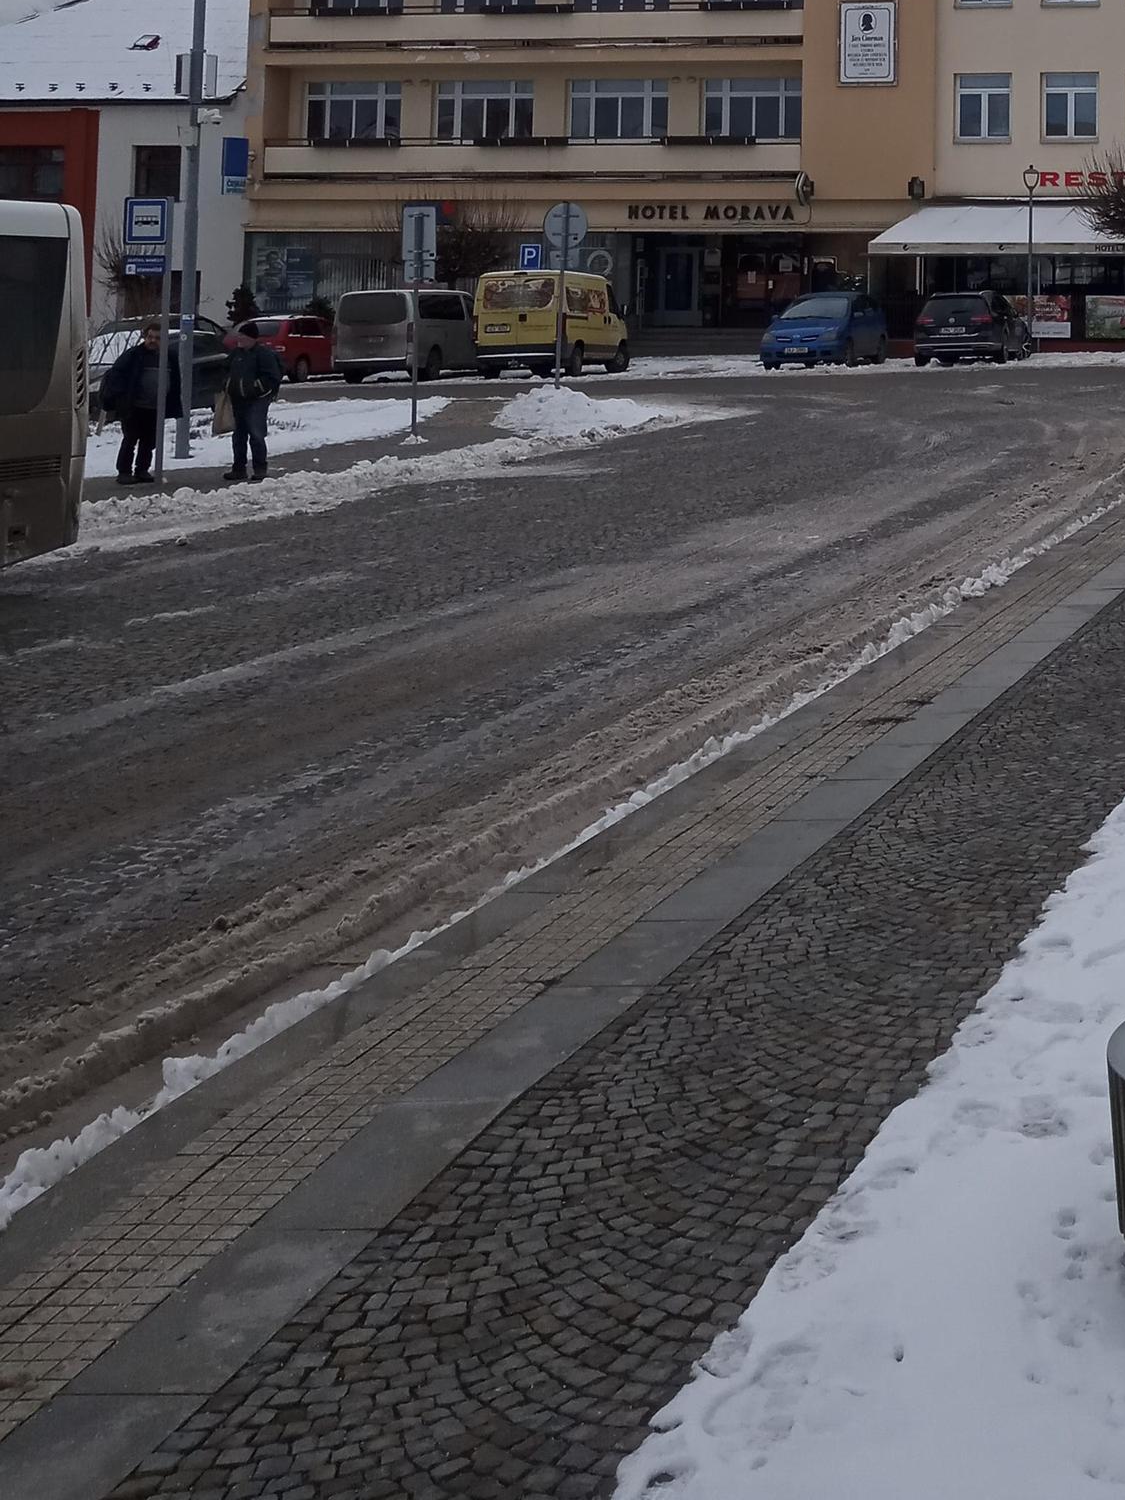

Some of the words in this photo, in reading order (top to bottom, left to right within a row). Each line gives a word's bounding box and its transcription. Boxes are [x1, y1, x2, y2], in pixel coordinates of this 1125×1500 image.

[627, 204, 690, 221] HOTEL
[703, 204, 795, 221] MORAVA
[1095, 244, 1122, 252] HOTEL
[524, 248, 537, 266] P
